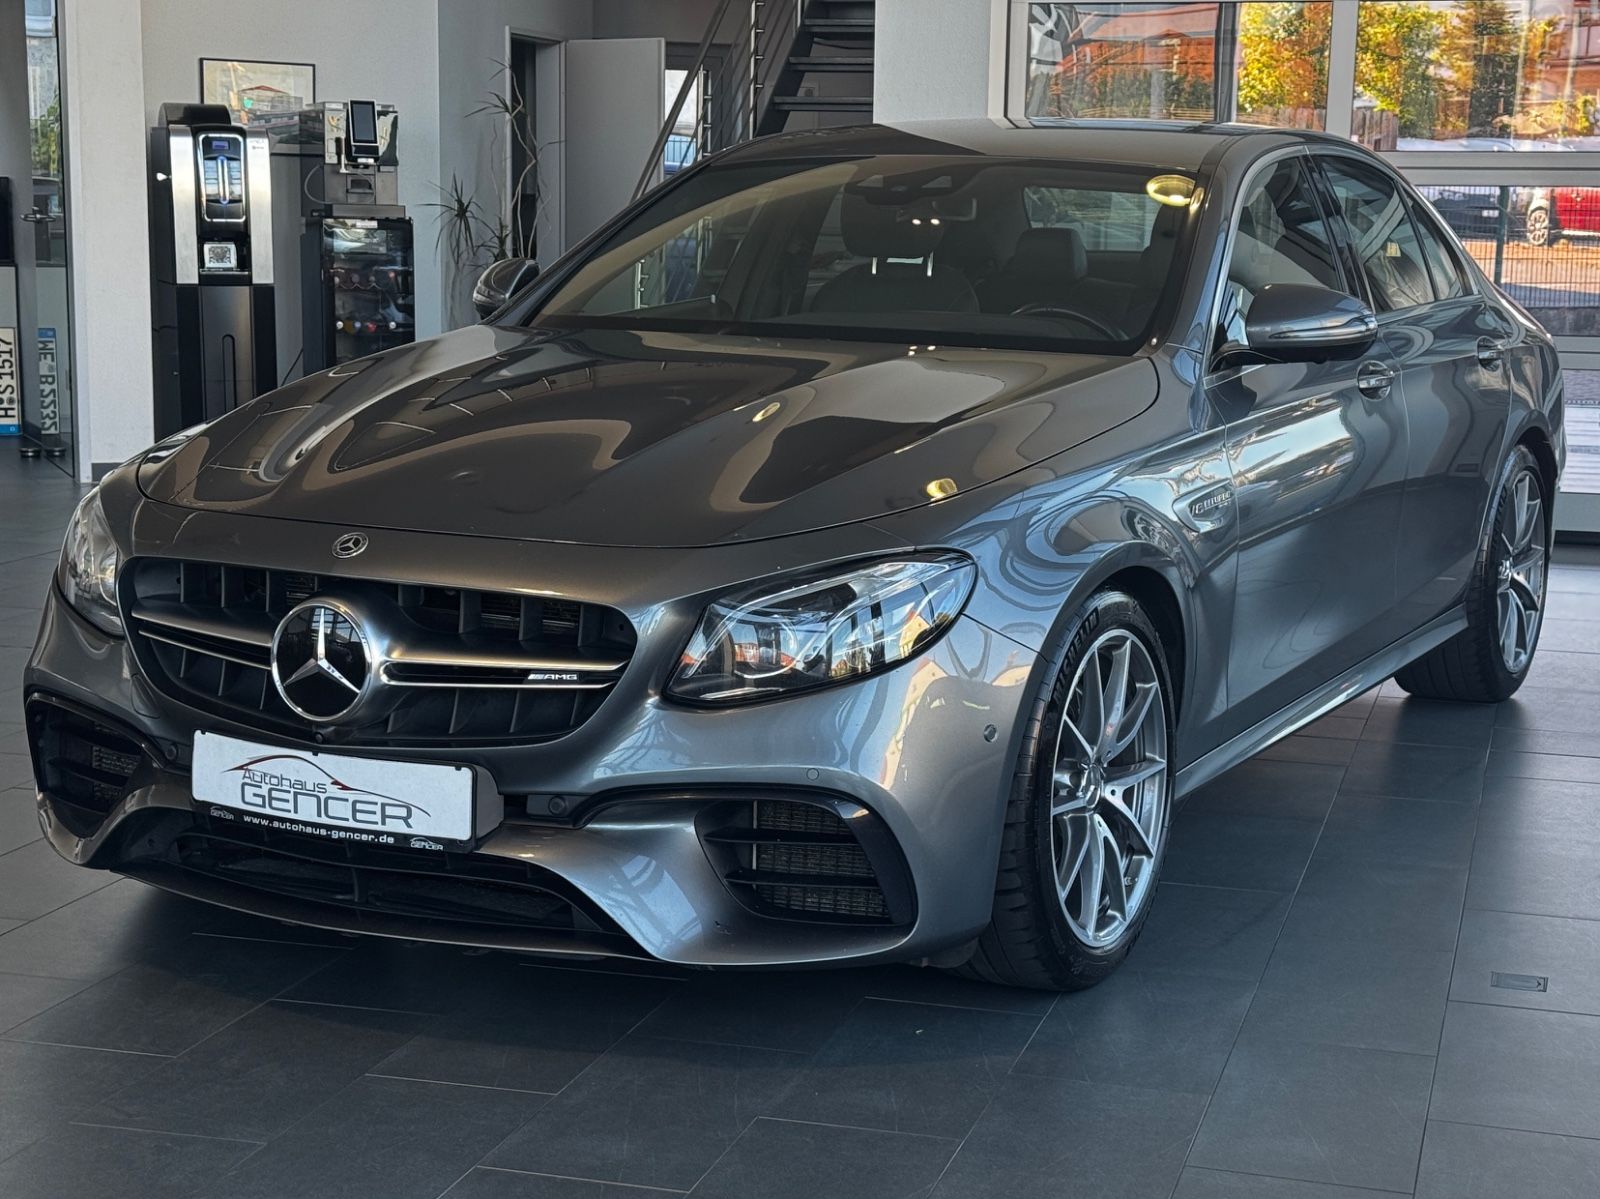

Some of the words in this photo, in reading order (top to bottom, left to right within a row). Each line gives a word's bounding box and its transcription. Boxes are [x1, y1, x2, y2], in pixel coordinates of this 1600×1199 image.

[0, 338, 14, 380] 1517
[0, 407, 16, 418] H
[242, 767, 327, 794] Autohaus
[241, 782, 413, 828] GENCER
[243, 815, 394, 844] www.autohaus-gencer.de
